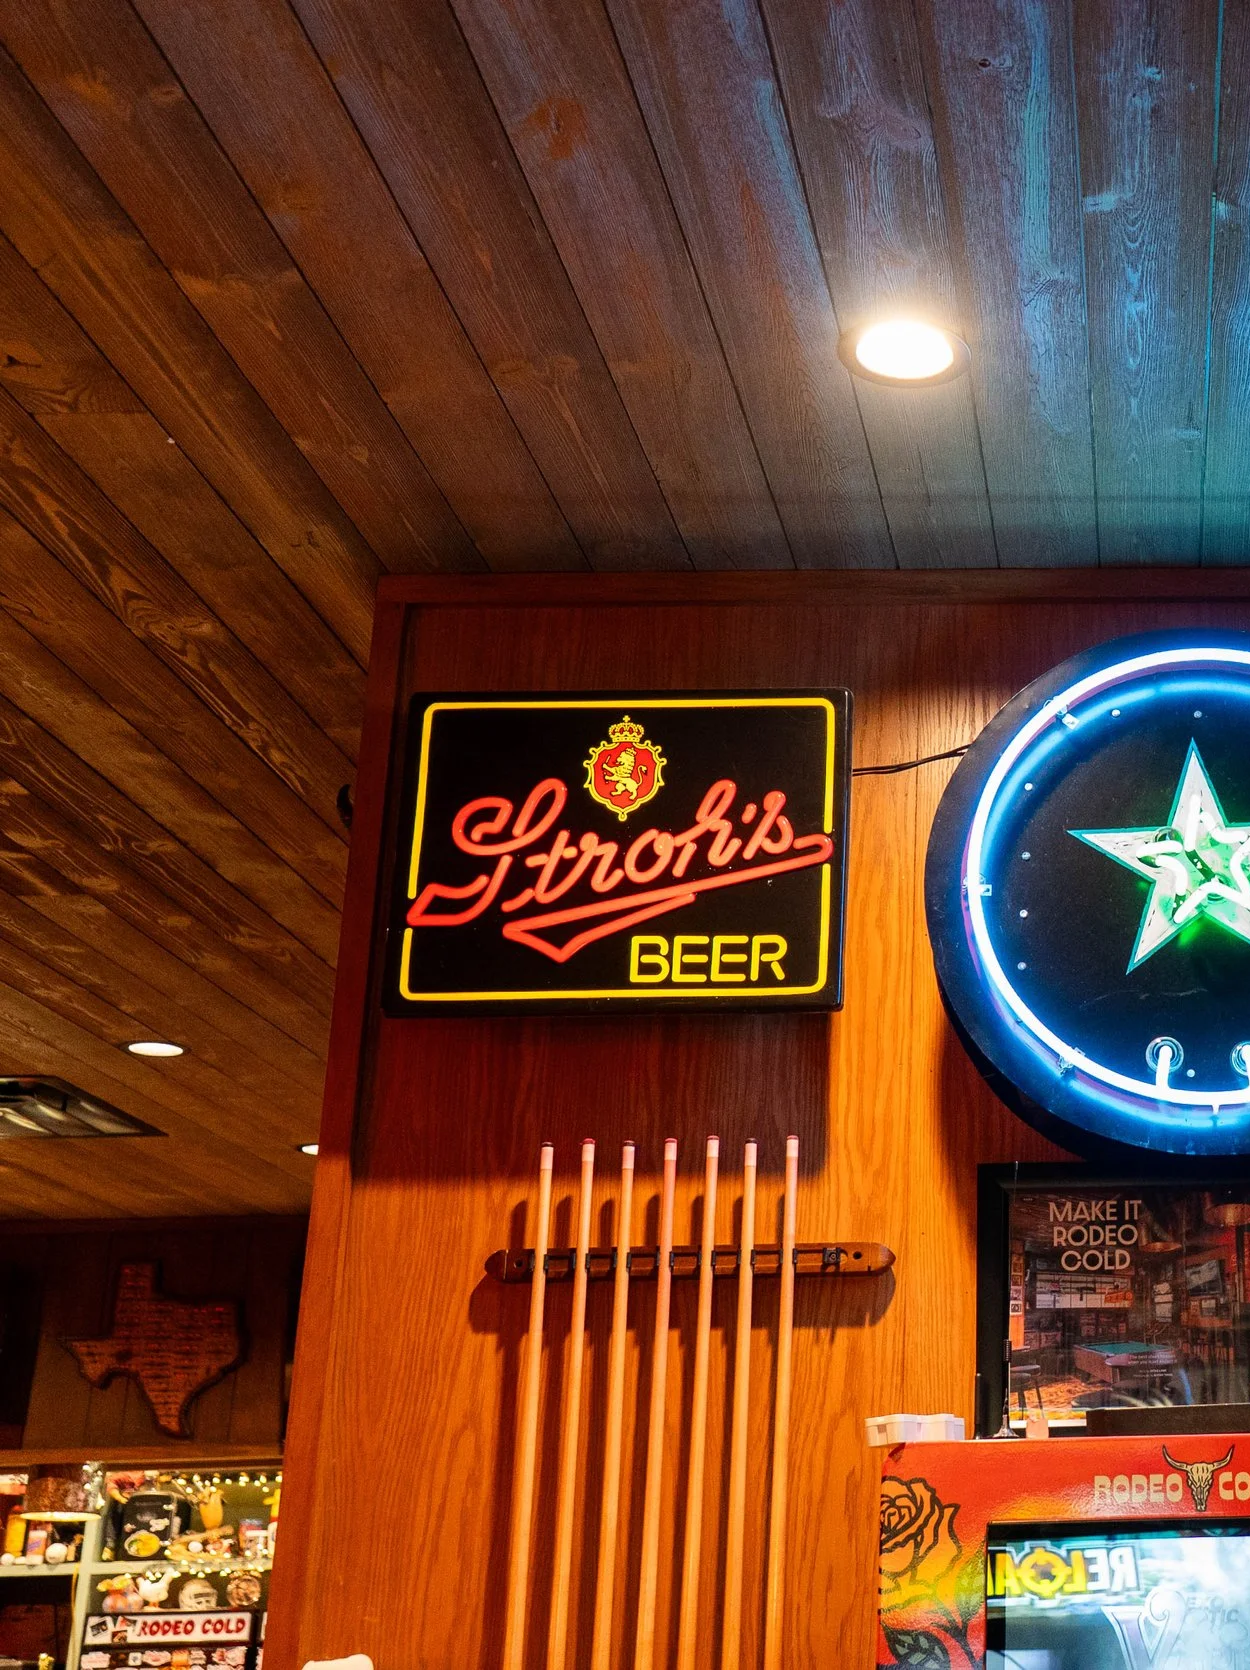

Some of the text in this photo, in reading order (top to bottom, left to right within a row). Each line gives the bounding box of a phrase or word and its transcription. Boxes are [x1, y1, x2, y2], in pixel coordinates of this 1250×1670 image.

[629, 934, 788, 984] BEER
[1048, 1199, 1142, 1222] MAKE IT
[1053, 1224, 1138, 1247] RODEO
[1061, 1249, 1131, 1271] COLD
[1094, 1473, 1183, 1503] RODEO
[139, 1618, 246, 1636] RODEO COLD
